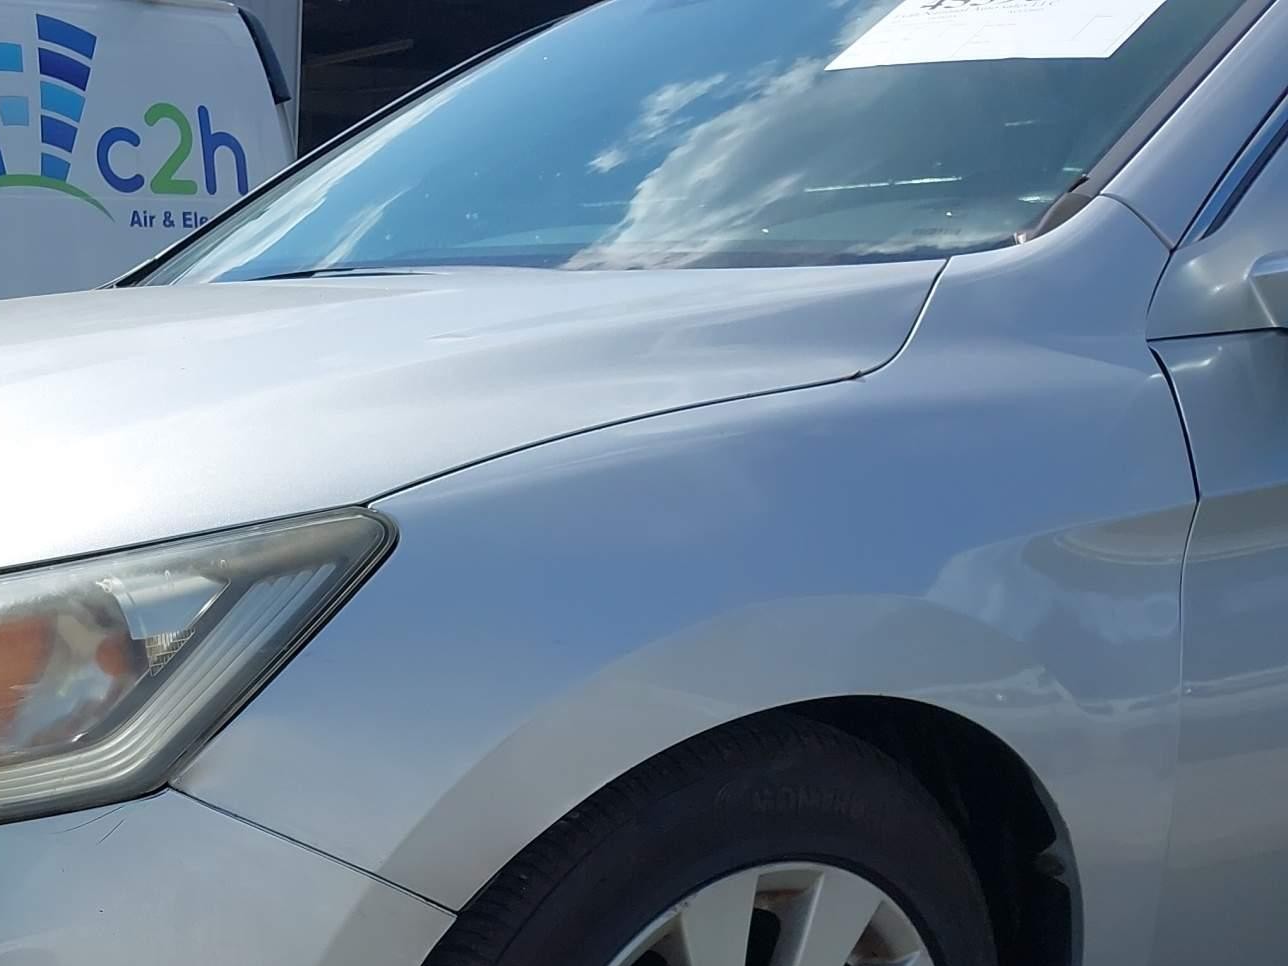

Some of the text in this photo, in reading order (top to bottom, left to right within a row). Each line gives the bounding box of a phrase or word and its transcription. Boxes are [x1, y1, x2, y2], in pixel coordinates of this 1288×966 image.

[96, 102, 249, 195] c2h
[130, 210, 215, 228] Air & Ele
